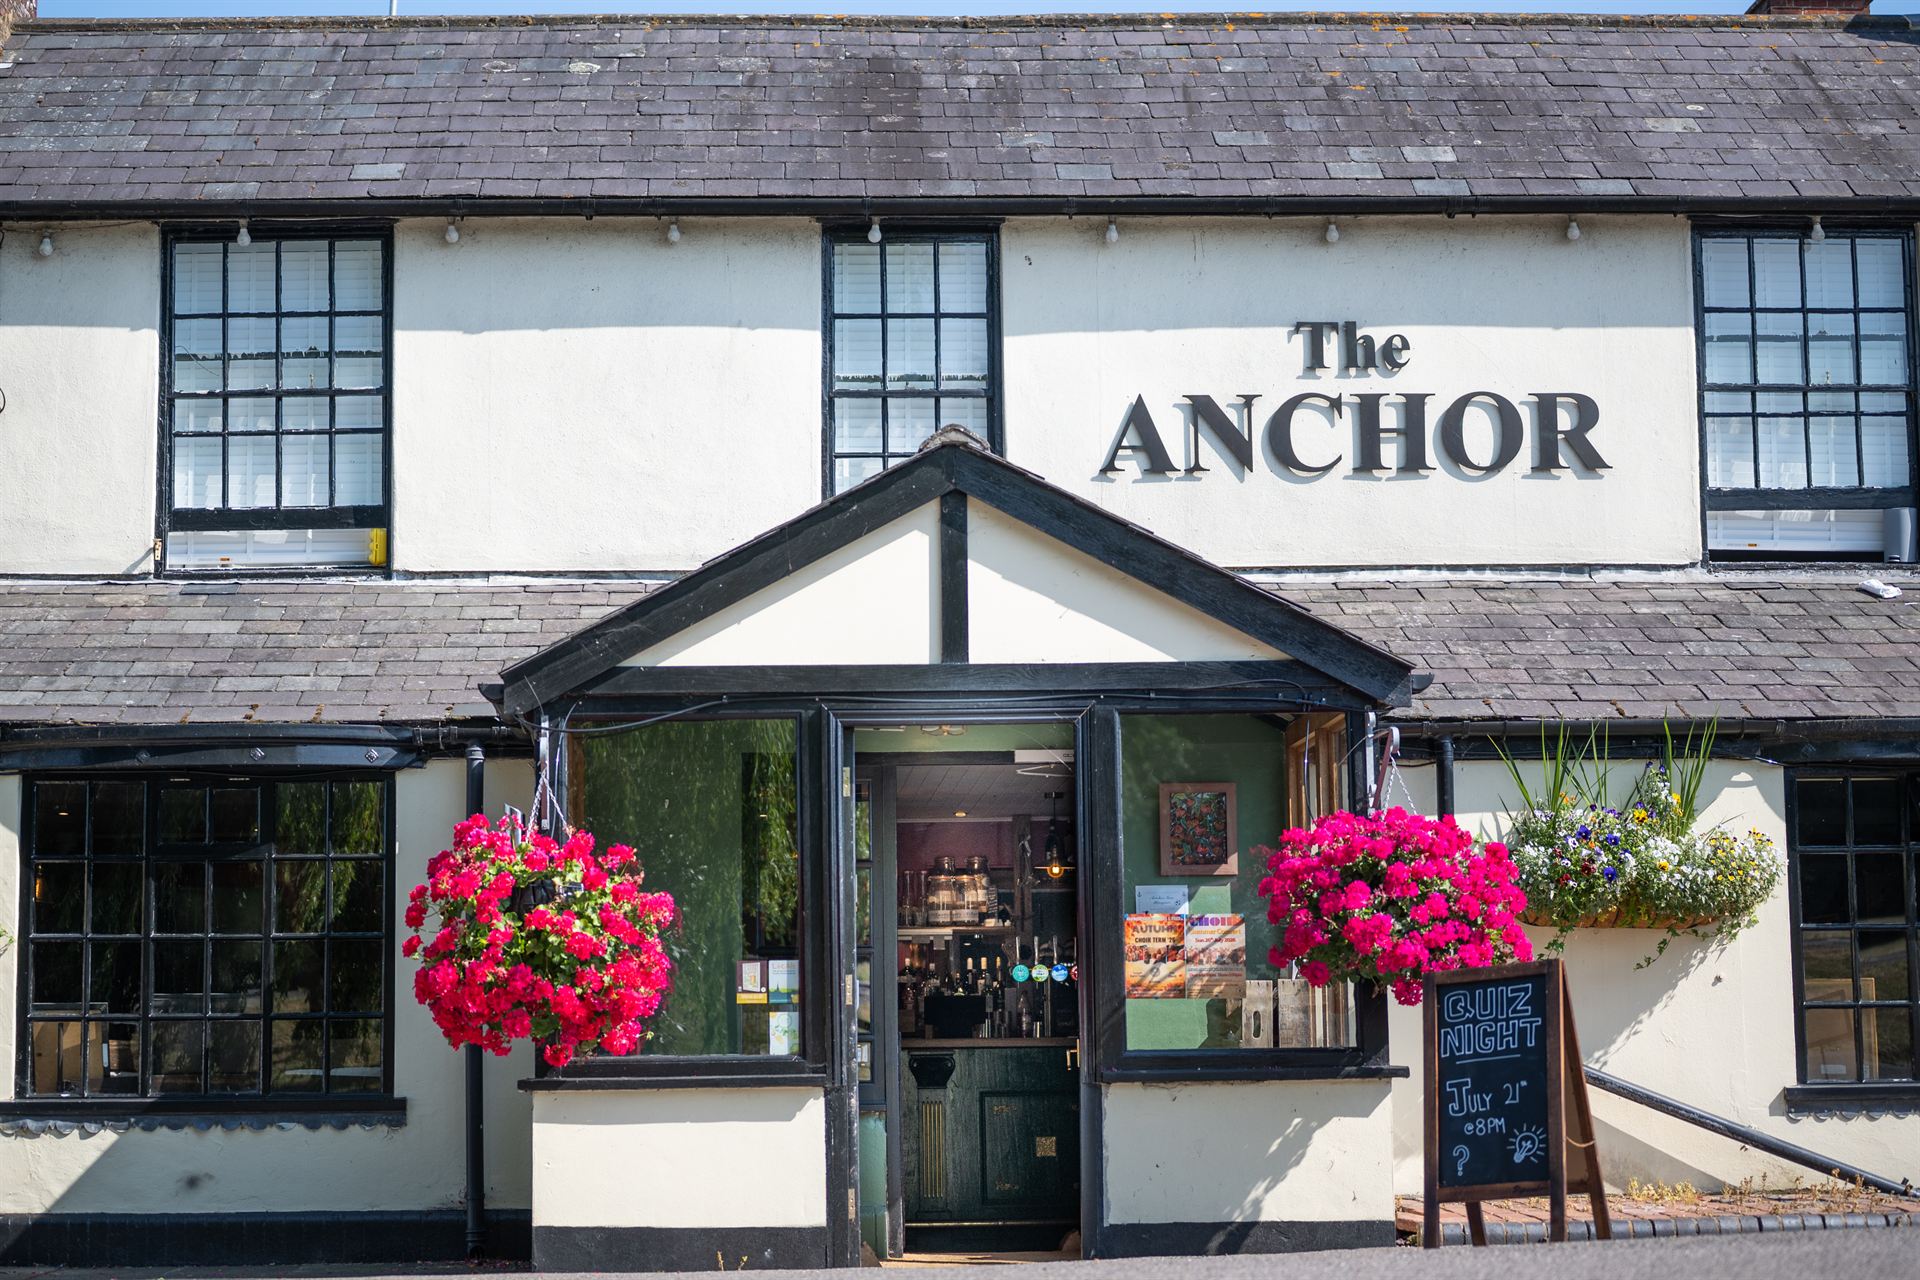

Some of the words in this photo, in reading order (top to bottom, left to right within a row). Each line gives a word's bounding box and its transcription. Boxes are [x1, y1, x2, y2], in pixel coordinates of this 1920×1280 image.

[1295, 320, 1411, 370] The
[1099, 391, 1613, 473] ANCHOR
[1132, 925, 1177, 934] AUTUMN
[1444, 983, 1532, 1022] QUIZ
[1441, 1018, 1542, 1058] NIGHT
[1464, 1117, 1506, 1136] @8PM
